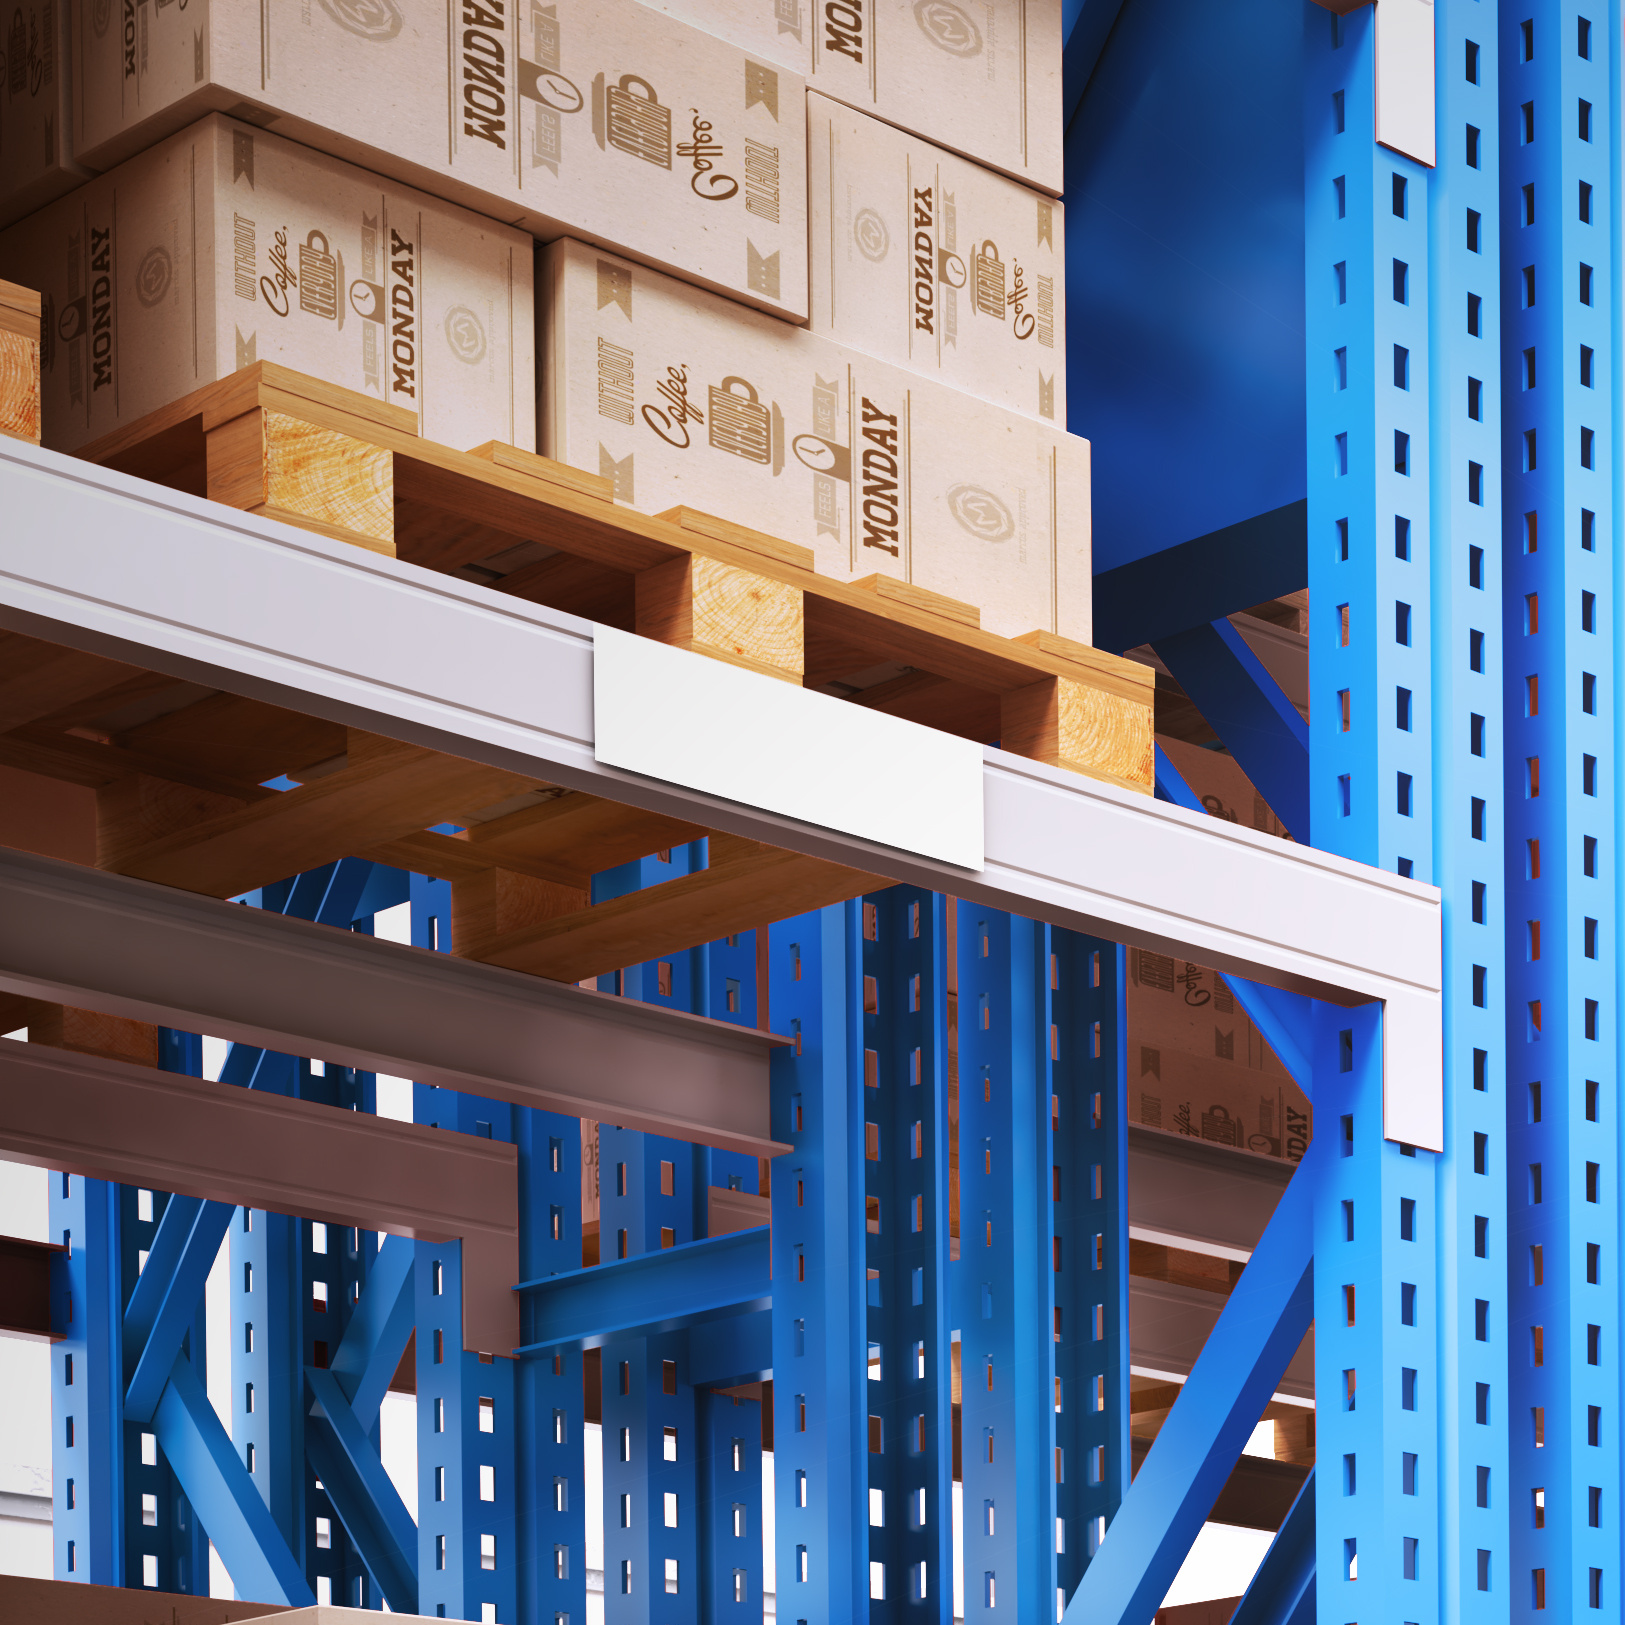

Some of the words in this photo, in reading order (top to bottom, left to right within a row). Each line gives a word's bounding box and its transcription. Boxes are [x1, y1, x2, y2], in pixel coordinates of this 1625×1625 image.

[234, 212, 256, 301] WITHOUT
[91, 227, 112, 392] MONDAY
[366, 329, 374, 367] FEELS
[391, 229, 415, 398] MONDAY
[598, 337, 634, 426] WITHOUT
[641, 363, 704, 449] Coffee,
[817, 406, 831, 434] LIKE
[818, 481, 832, 519] FEELS
[862, 397, 899, 558] MONDAY
